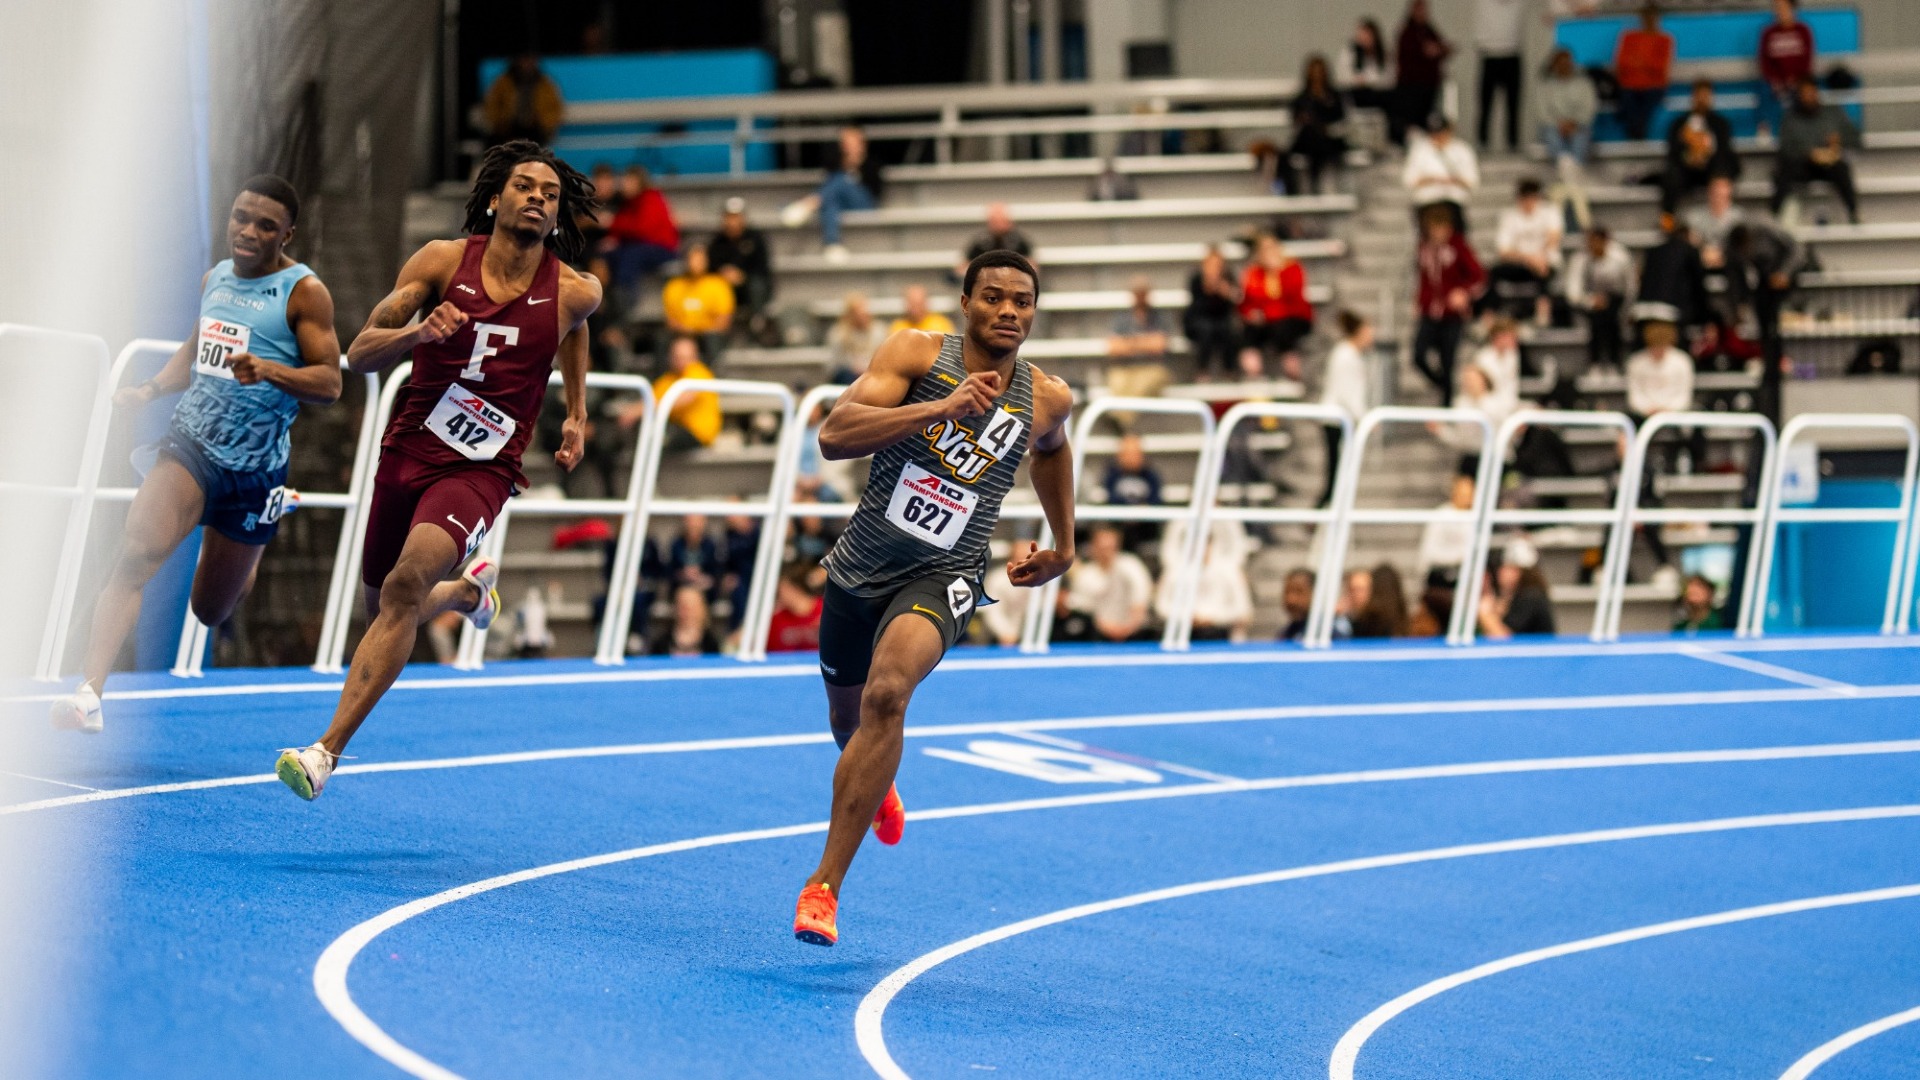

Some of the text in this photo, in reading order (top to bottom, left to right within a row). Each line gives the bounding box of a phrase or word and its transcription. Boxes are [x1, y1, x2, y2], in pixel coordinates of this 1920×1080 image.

[234, 294, 265, 311] ISLAND
[208, 322, 238, 336] A10
[200, 341, 233, 369] 507
[460, 322, 519, 382] F
[449, 396, 507, 437] CHAMPIONSHIPS
[461, 396, 504, 425] A10
[445, 412, 489, 451] 412
[988, 418, 1016, 453] 4
[925, 419, 991, 481] VCU
[903, 479, 968, 514] CHAMPIONSHIPS
[916, 475, 964, 501] A10
[903, 495, 954, 535] 627
[952, 589, 971, 611] 4
